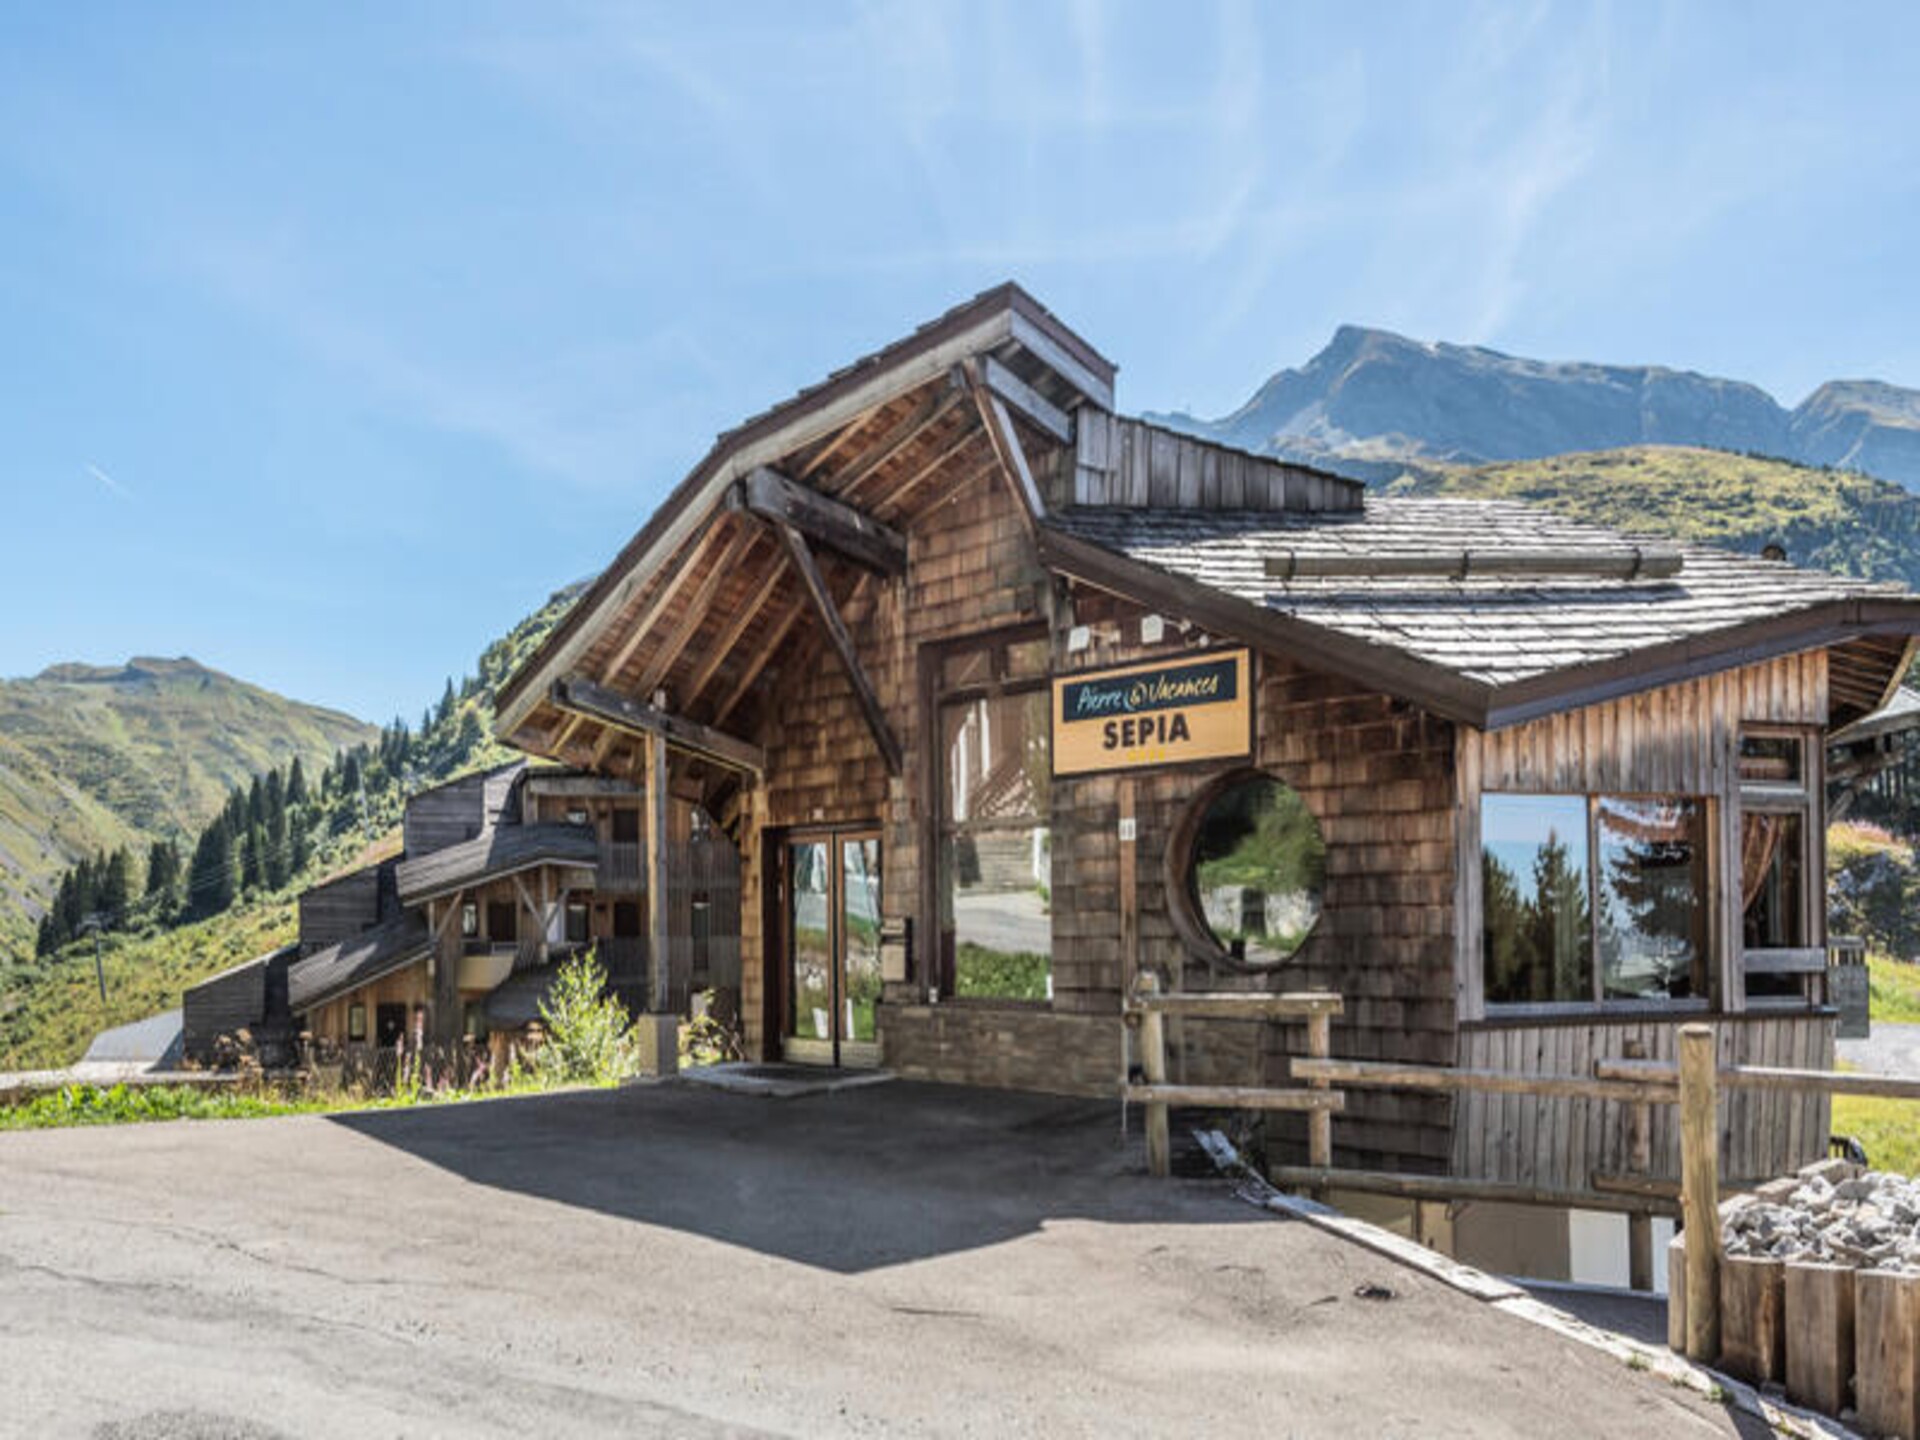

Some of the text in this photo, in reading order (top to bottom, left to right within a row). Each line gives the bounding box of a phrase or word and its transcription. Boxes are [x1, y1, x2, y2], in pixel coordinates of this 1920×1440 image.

[1077, 685, 1122, 713] Pierre
[1148, 675, 1219, 704] Vacances
[1103, 713, 1190, 750] SEPIA
